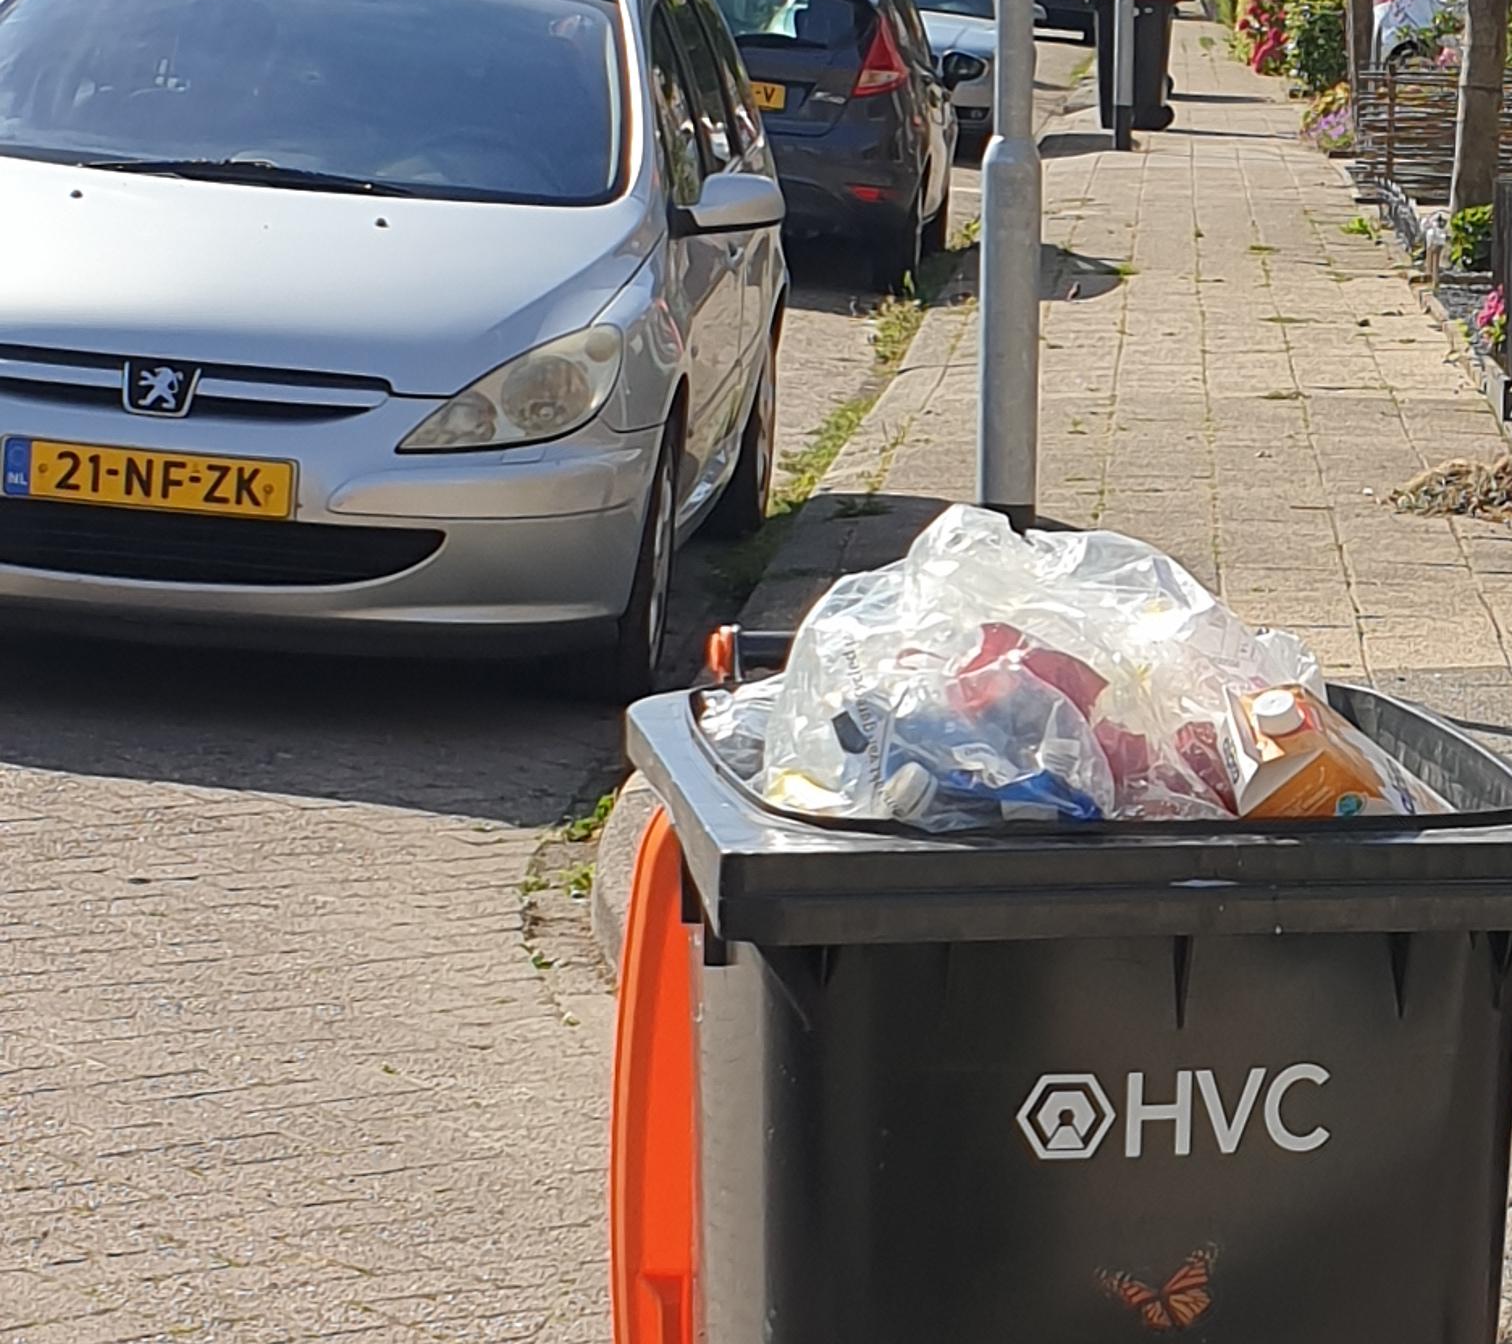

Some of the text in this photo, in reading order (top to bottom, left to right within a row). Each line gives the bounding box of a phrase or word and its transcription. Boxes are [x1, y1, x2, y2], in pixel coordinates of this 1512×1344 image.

[7, 472, 28, 486] NL
[54, 450, 262, 507] 21-NF-ZK
[1125, 1062, 1331, 1158] HVC
